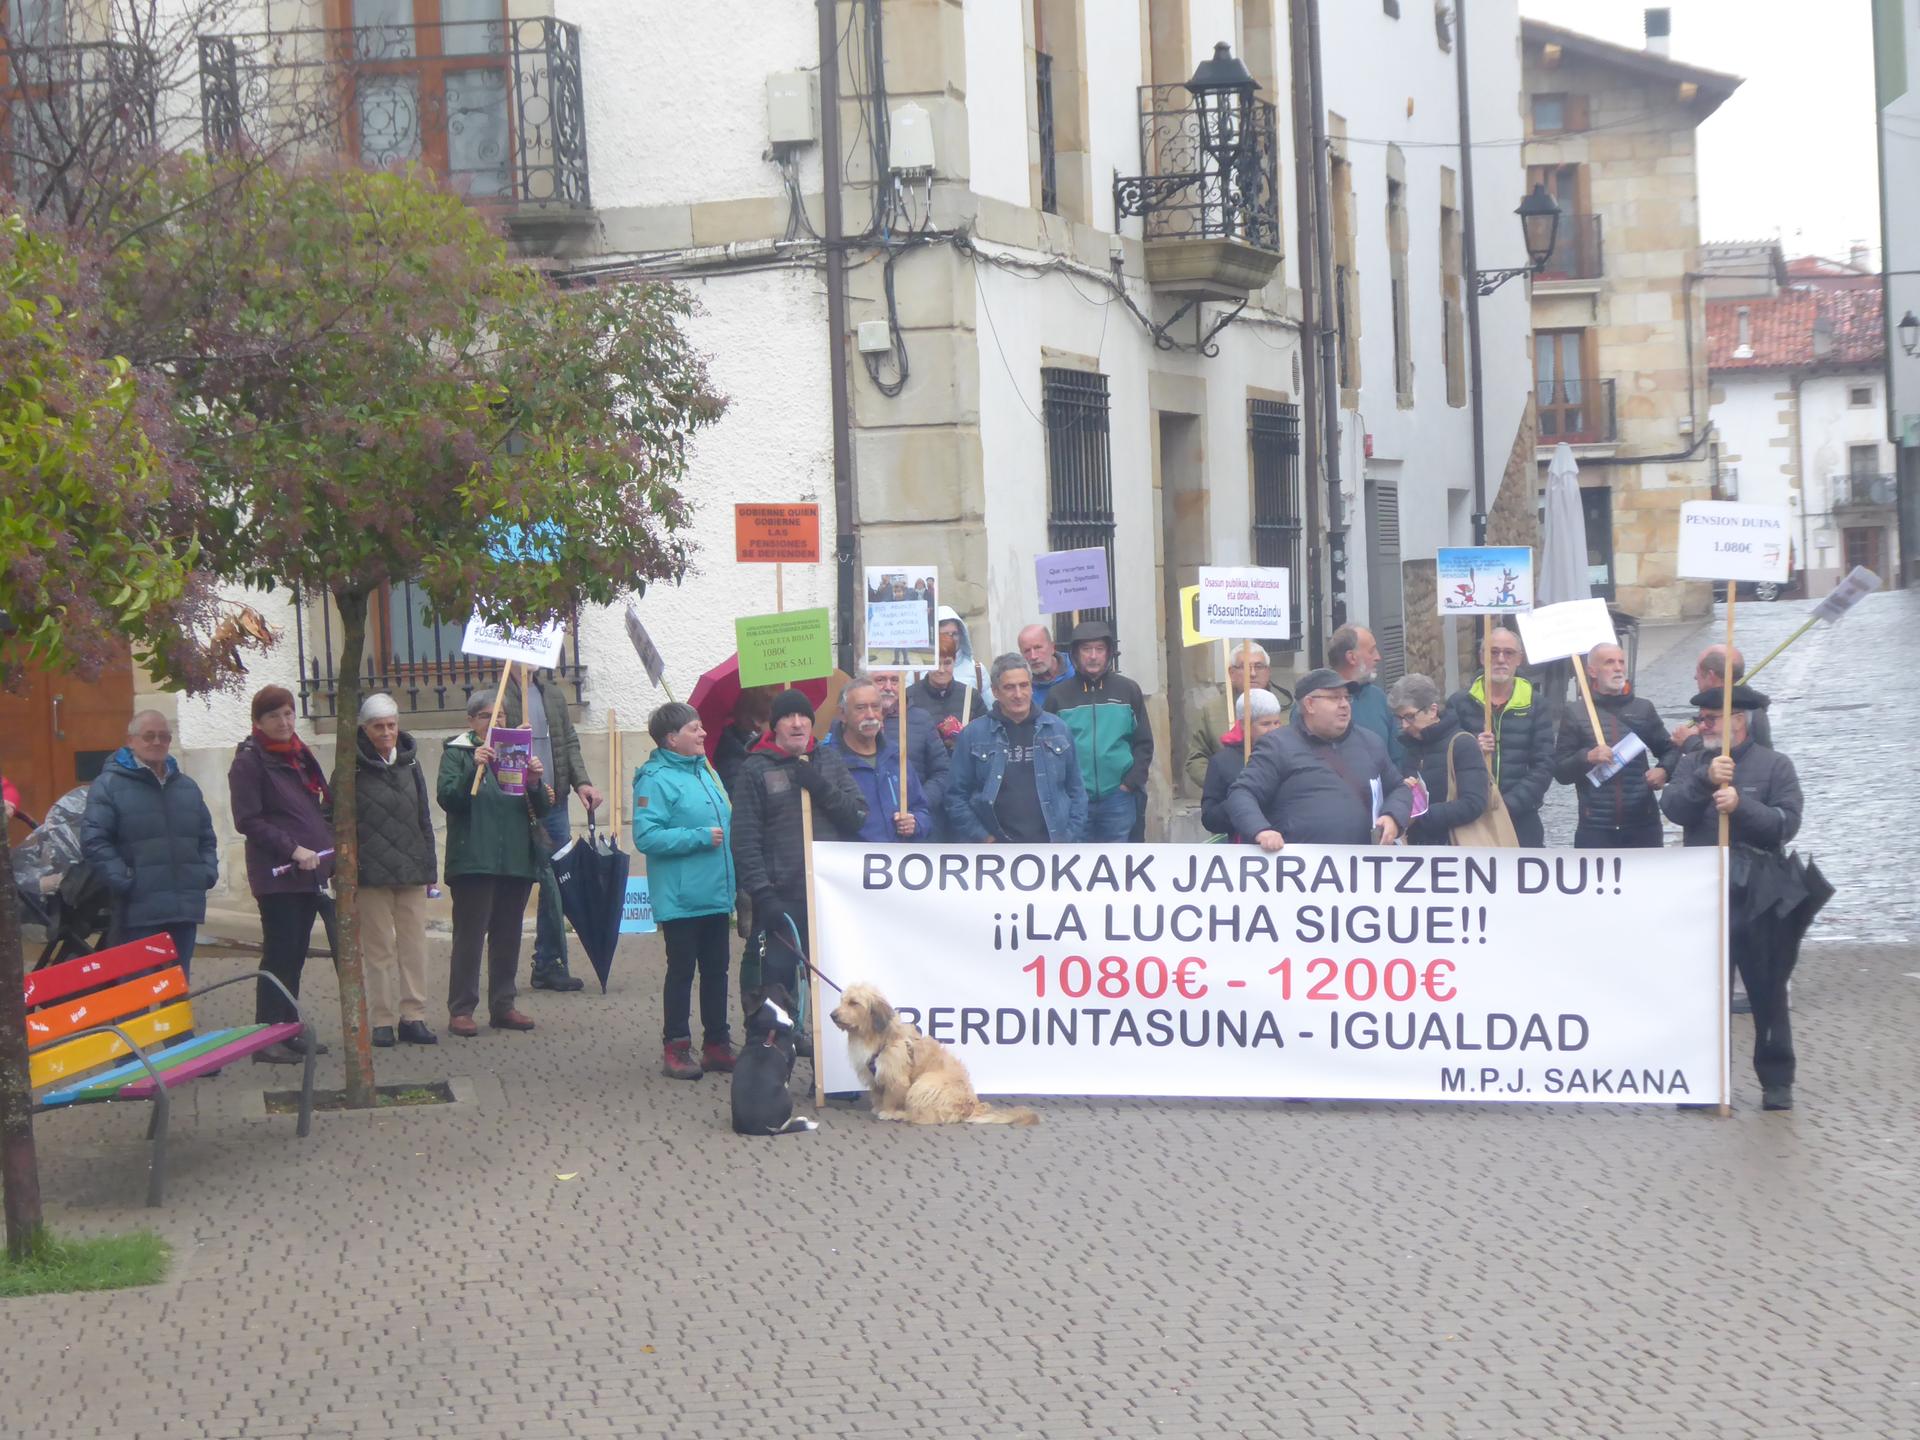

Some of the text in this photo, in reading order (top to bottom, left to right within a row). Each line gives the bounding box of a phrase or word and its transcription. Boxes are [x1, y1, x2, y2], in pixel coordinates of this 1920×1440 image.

[739, 508, 816, 517] GOBIERNE QUIEN
[754, 518, 801, 526] GOBIERNE
[1686, 514, 1781, 528] PENSION DUINA
[767, 528, 788, 536] LAS
[750, 539, 807, 547] PENSIONES
[1713, 541, 1752, 554] 1.080€
[742, 549, 815, 558] SE DEFIENDEN
[1204, 578, 1225, 588] Osasun
[1207, 604, 1282, 618] #OsasunEtxeaZaindu
[862, 853, 1622, 895] BORROKAK JARRAITZEN DU!!
[994, 903, 1487, 951] ¡¡LA LUCHA SIGUE!!
[1022, 954, 1457, 1002] 1080€ - 1200€
[895, 1007, 1285, 1049] BERDINTASUNA
[1330, 1011, 1589, 1052] IGUALDAD
[1441, 1067, 1690, 1095] M.P.J. SAKANA
